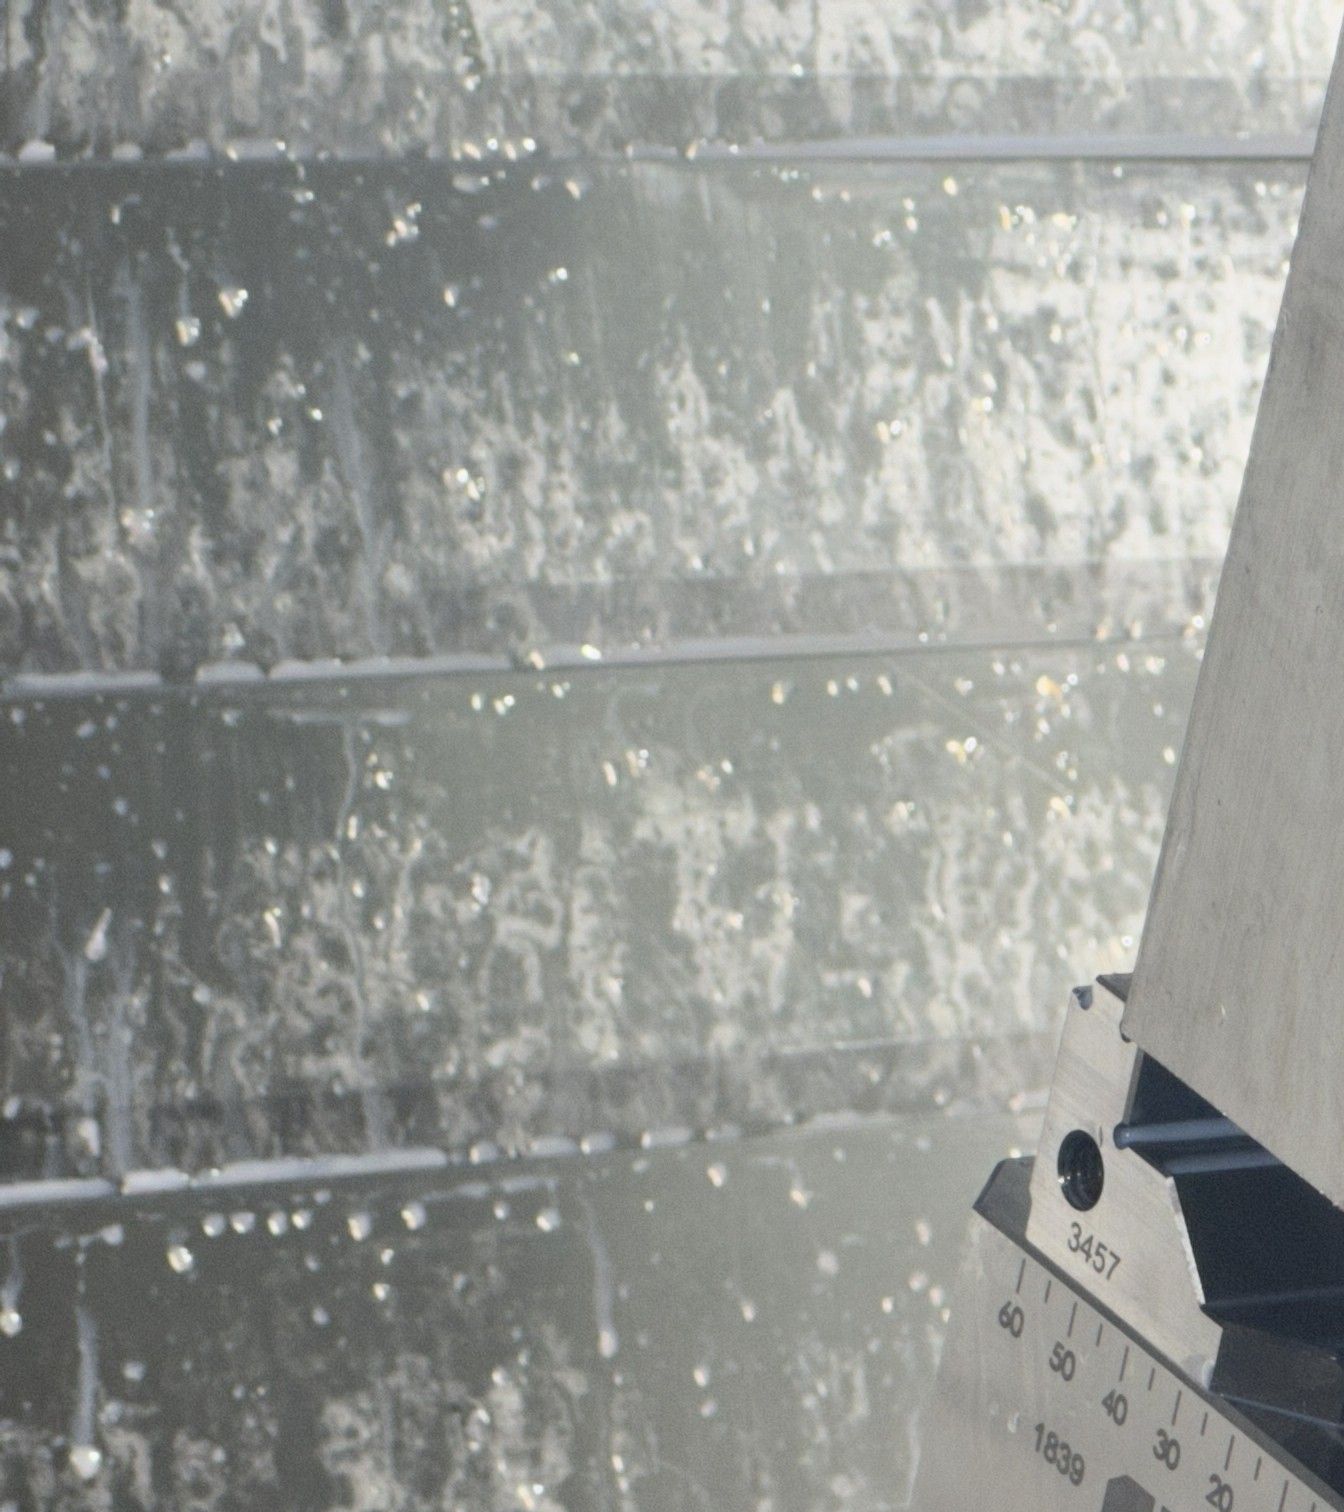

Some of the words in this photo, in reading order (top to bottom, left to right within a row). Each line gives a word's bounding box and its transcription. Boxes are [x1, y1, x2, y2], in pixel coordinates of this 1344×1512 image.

[1067, 1221, 1121, 1280] 3457
[998, 1300, 1024, 1338] 60
[1049, 1340, 1076, 1382] 50
[1101, 1388, 1128, 1426] 40
[1152, 1428, 1180, 1471] 30
[1034, 1422, 1085, 1486] 1839
